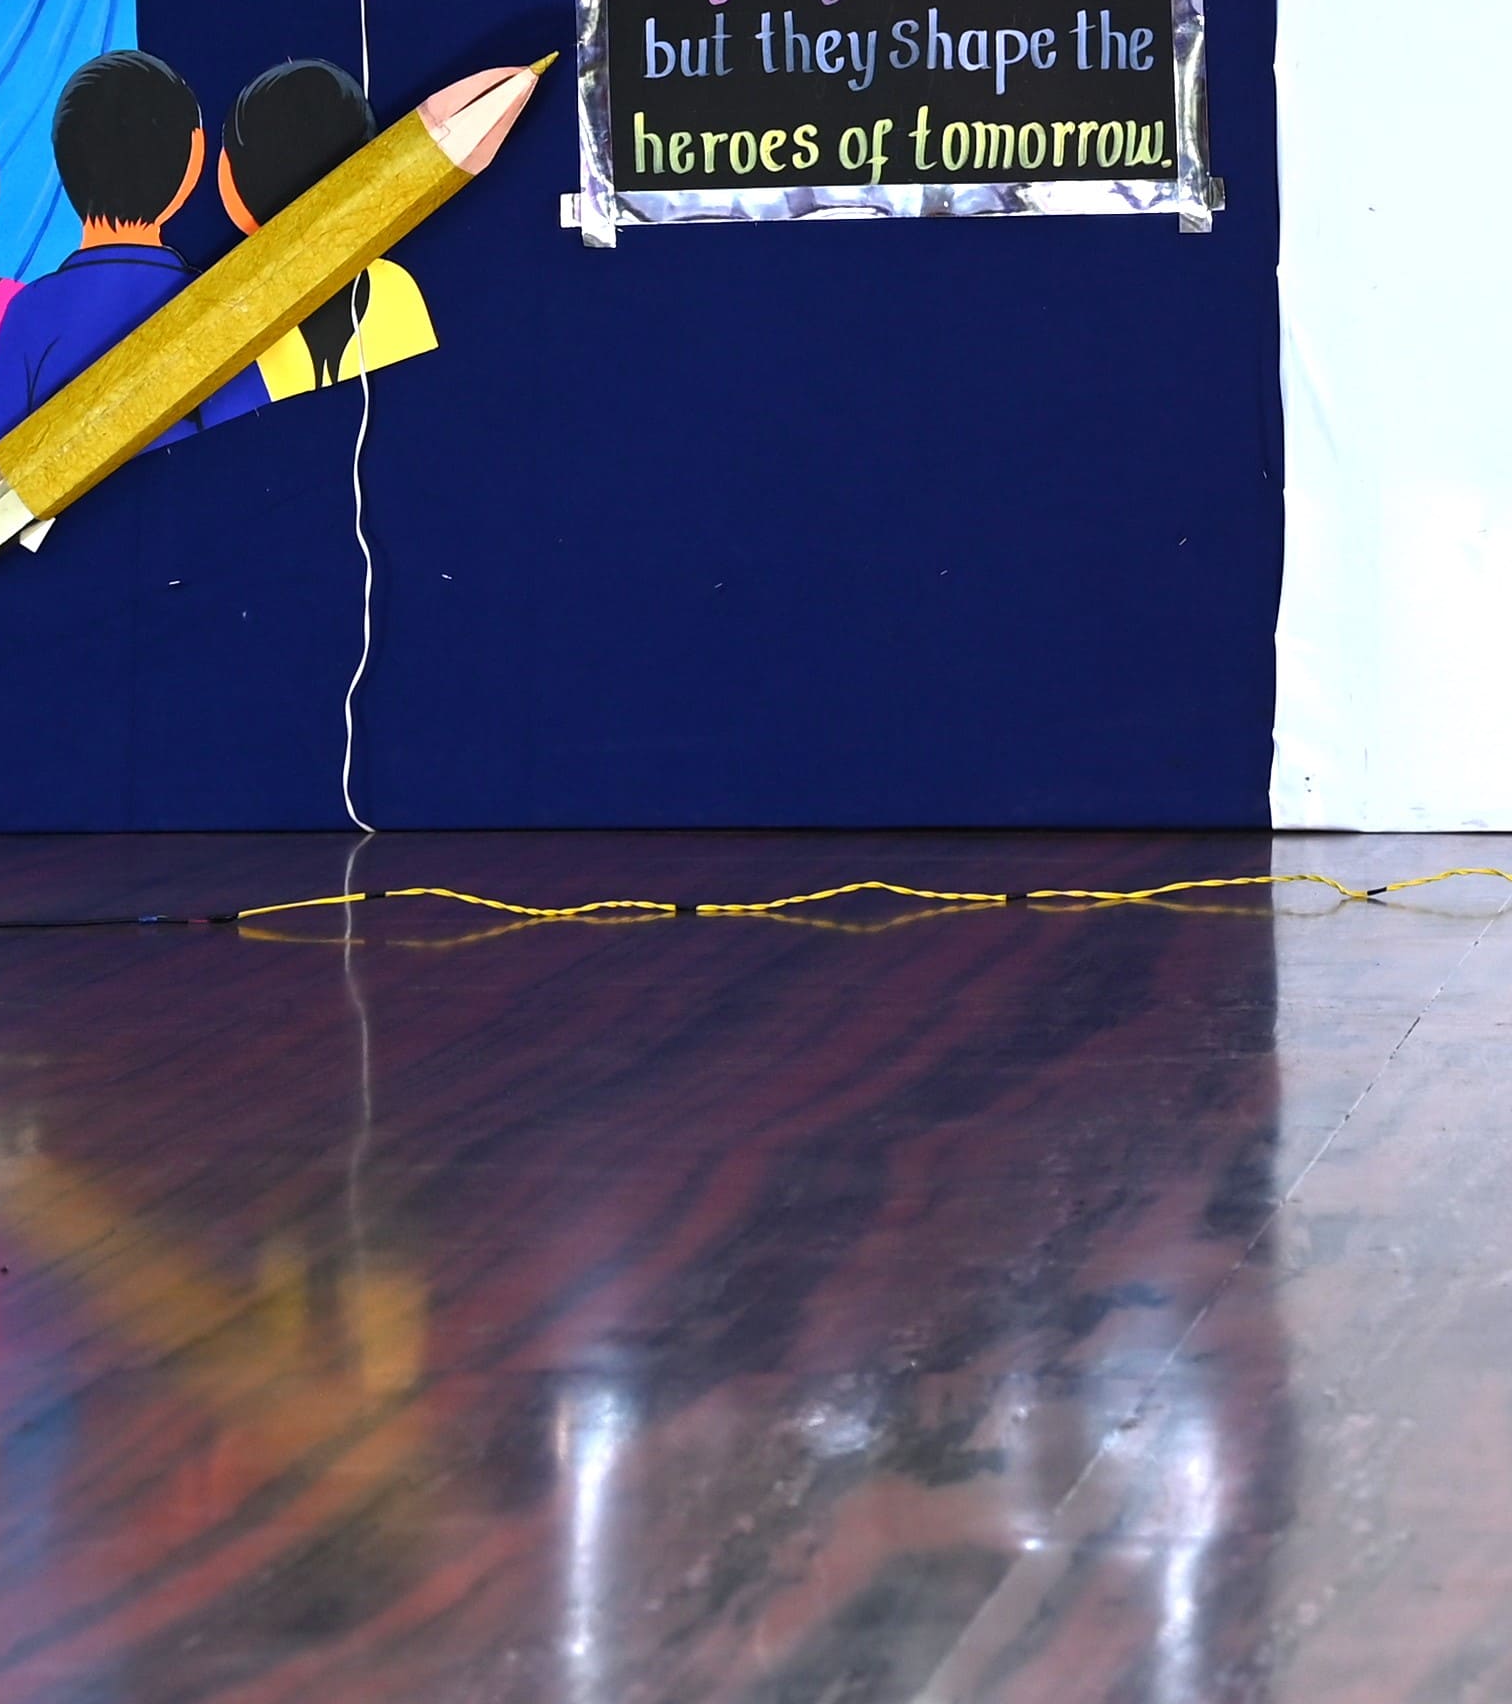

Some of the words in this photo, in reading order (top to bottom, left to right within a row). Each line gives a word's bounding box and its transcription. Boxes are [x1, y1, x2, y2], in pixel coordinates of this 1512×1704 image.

[642, 12, 734, 79] but
[754, 9, 878, 91] they
[888, 7, 1058, 95] shape
[1069, 8, 1155, 72] the
[632, 111, 819, 176] heroes
[838, 116, 894, 186] of
[908, 105, 1174, 172] tomorrow.
